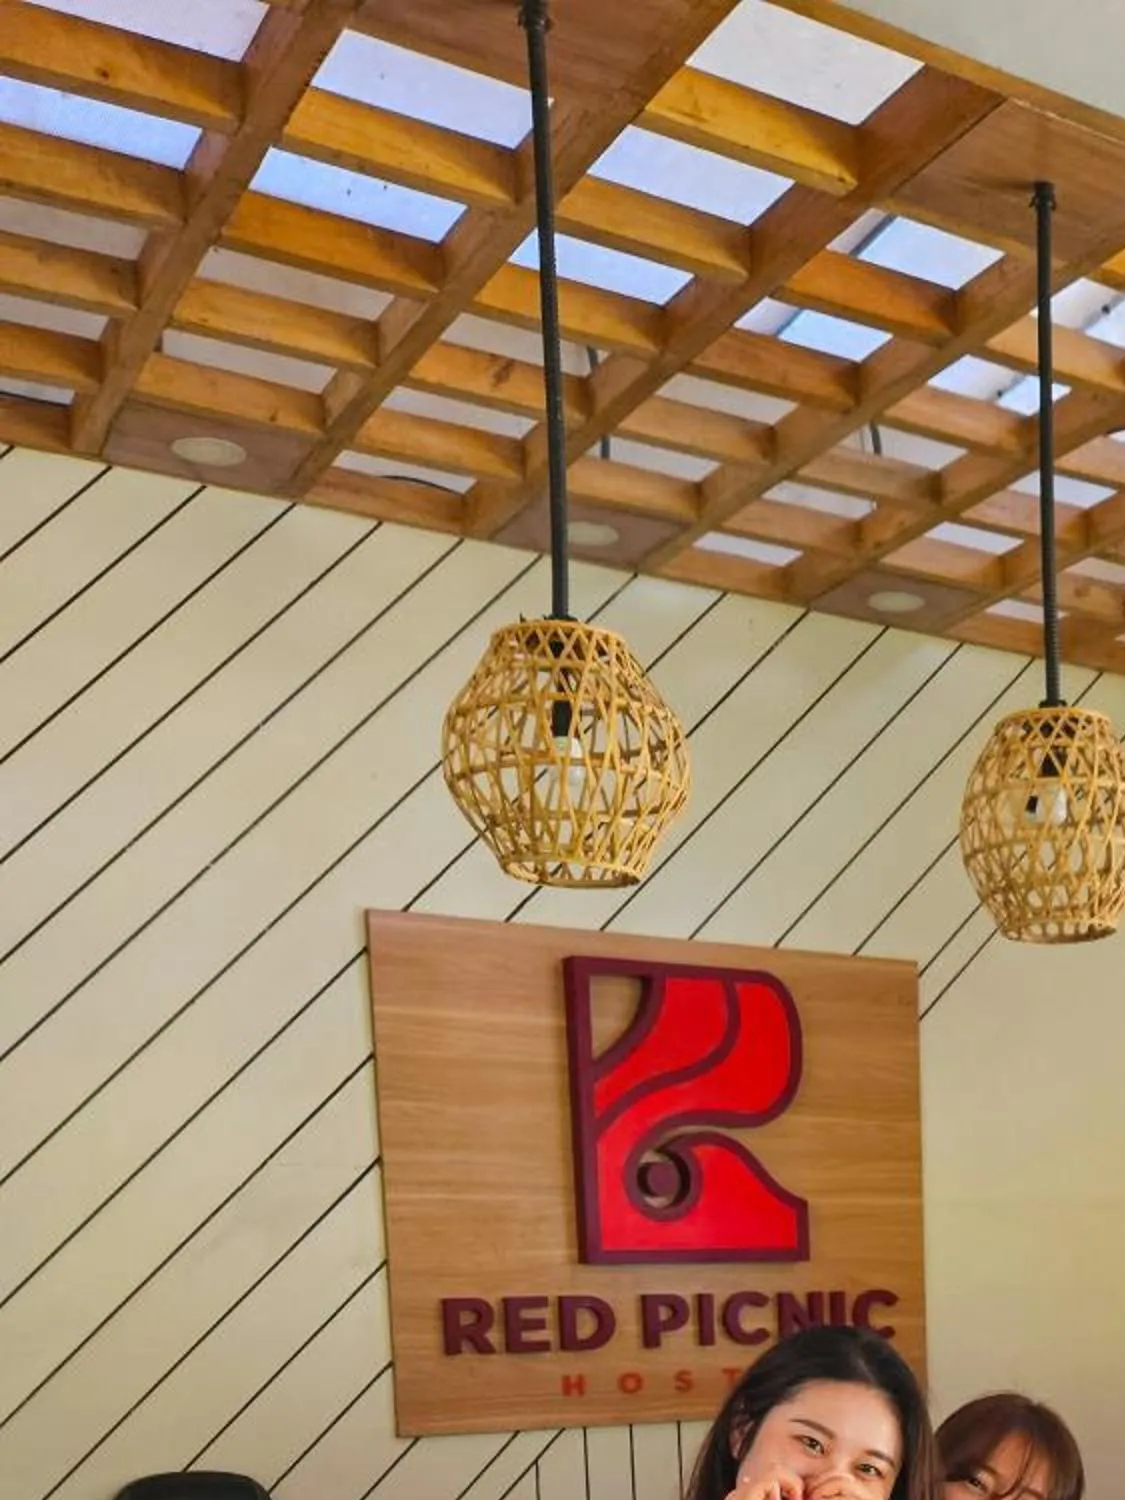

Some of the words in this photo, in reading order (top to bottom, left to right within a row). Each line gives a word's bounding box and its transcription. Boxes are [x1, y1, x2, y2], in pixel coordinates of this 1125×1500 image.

[439, 1294, 617, 1357] RED
[639, 1289, 900, 1350] PICNIC
[561, 1367, 743, 1398] HOST
